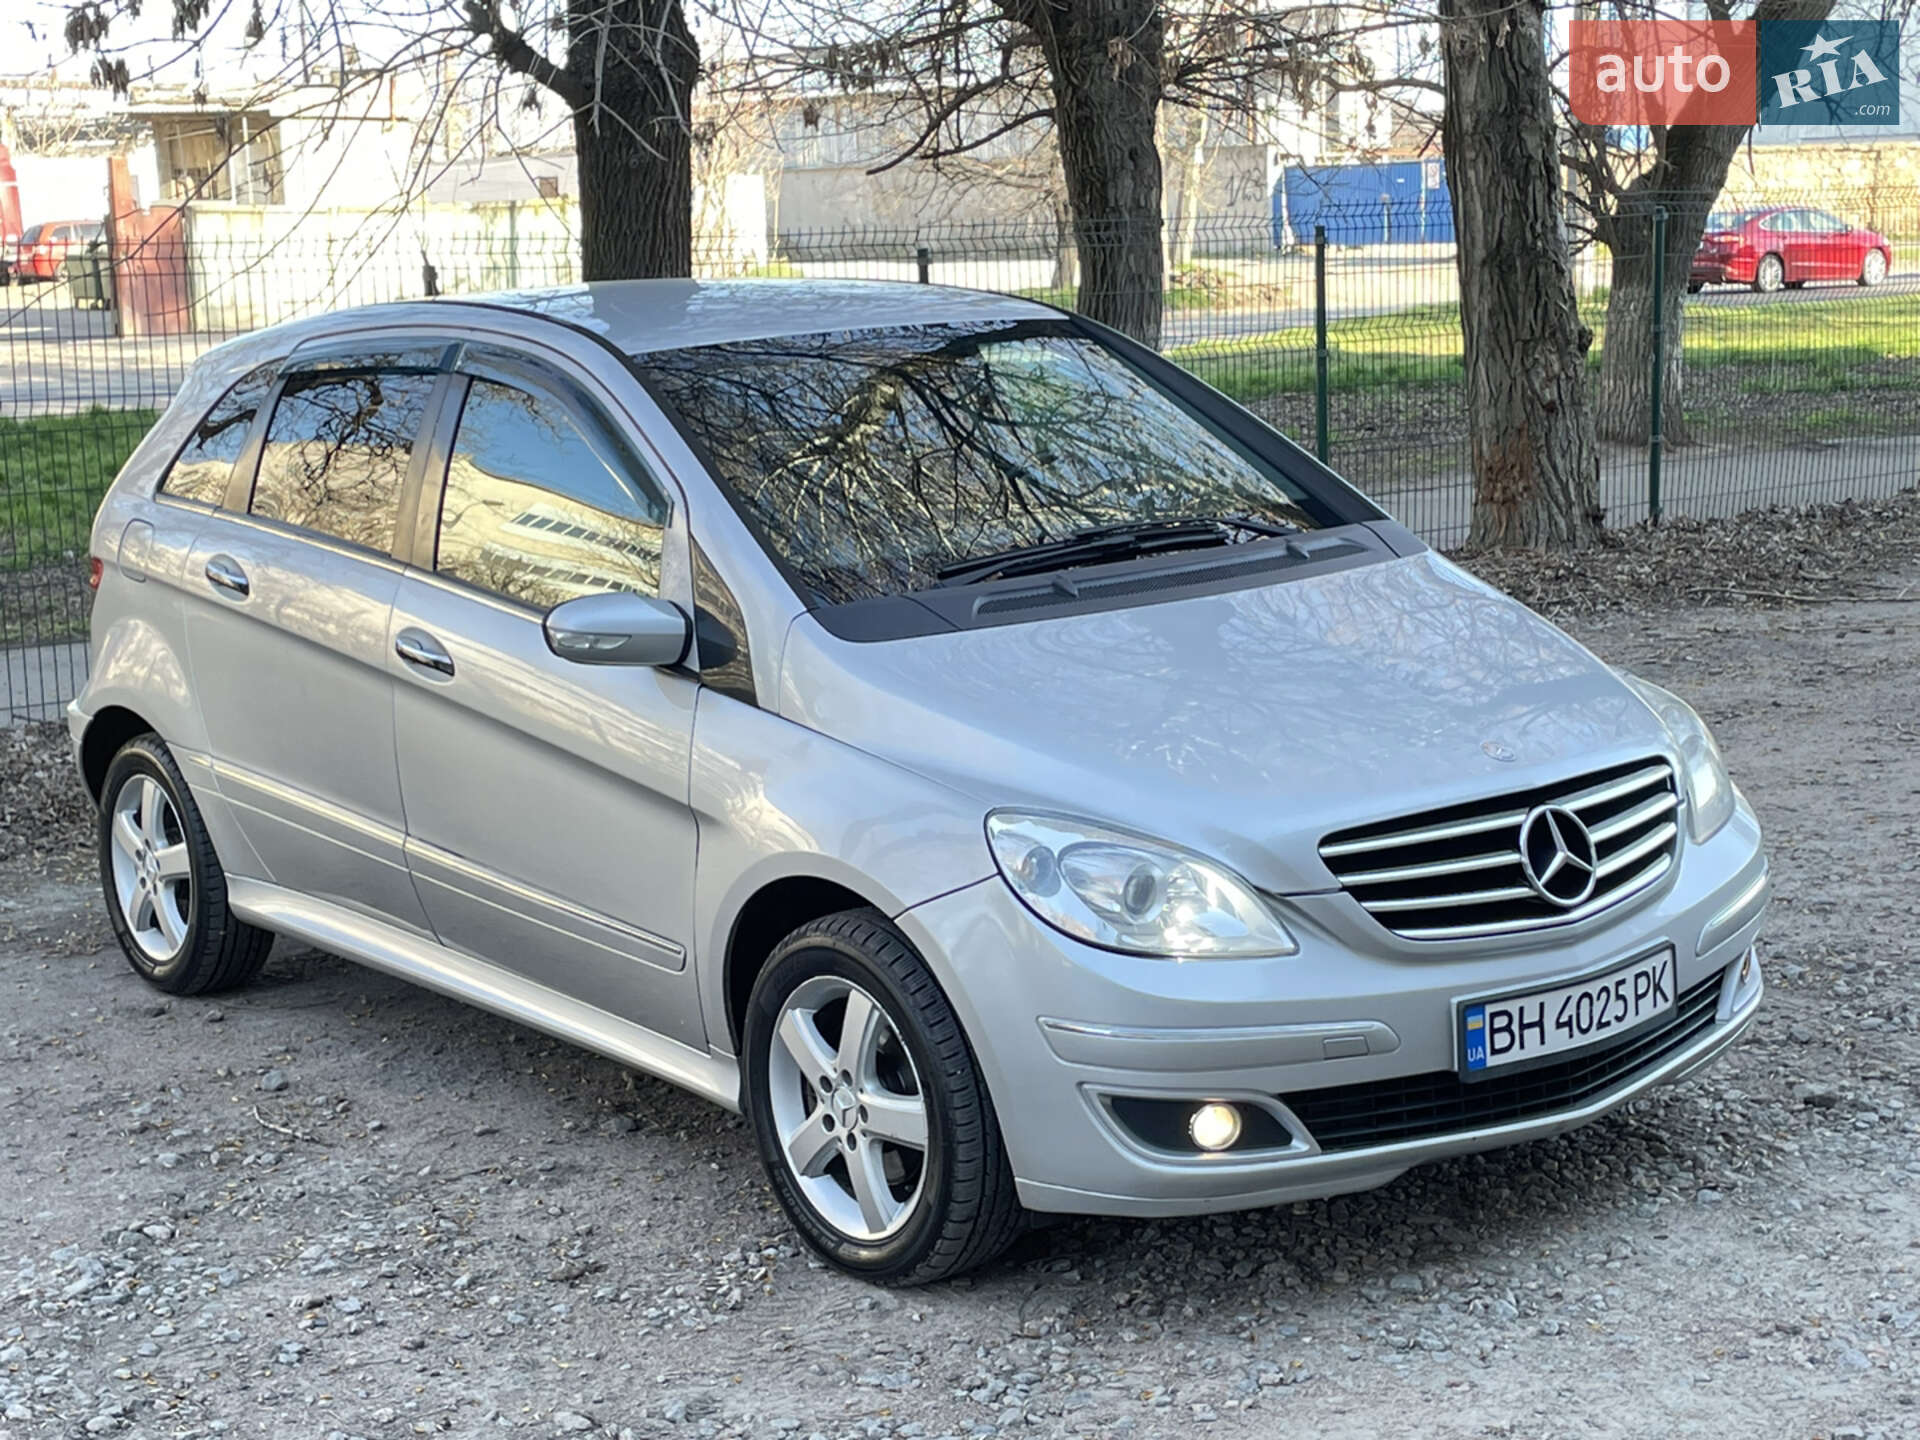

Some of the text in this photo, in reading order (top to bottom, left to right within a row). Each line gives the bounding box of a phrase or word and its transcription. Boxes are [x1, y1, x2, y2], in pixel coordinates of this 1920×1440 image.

[1489, 960, 1669, 1057] BH 4025 PK
[1467, 1046, 1485, 1062] UA
